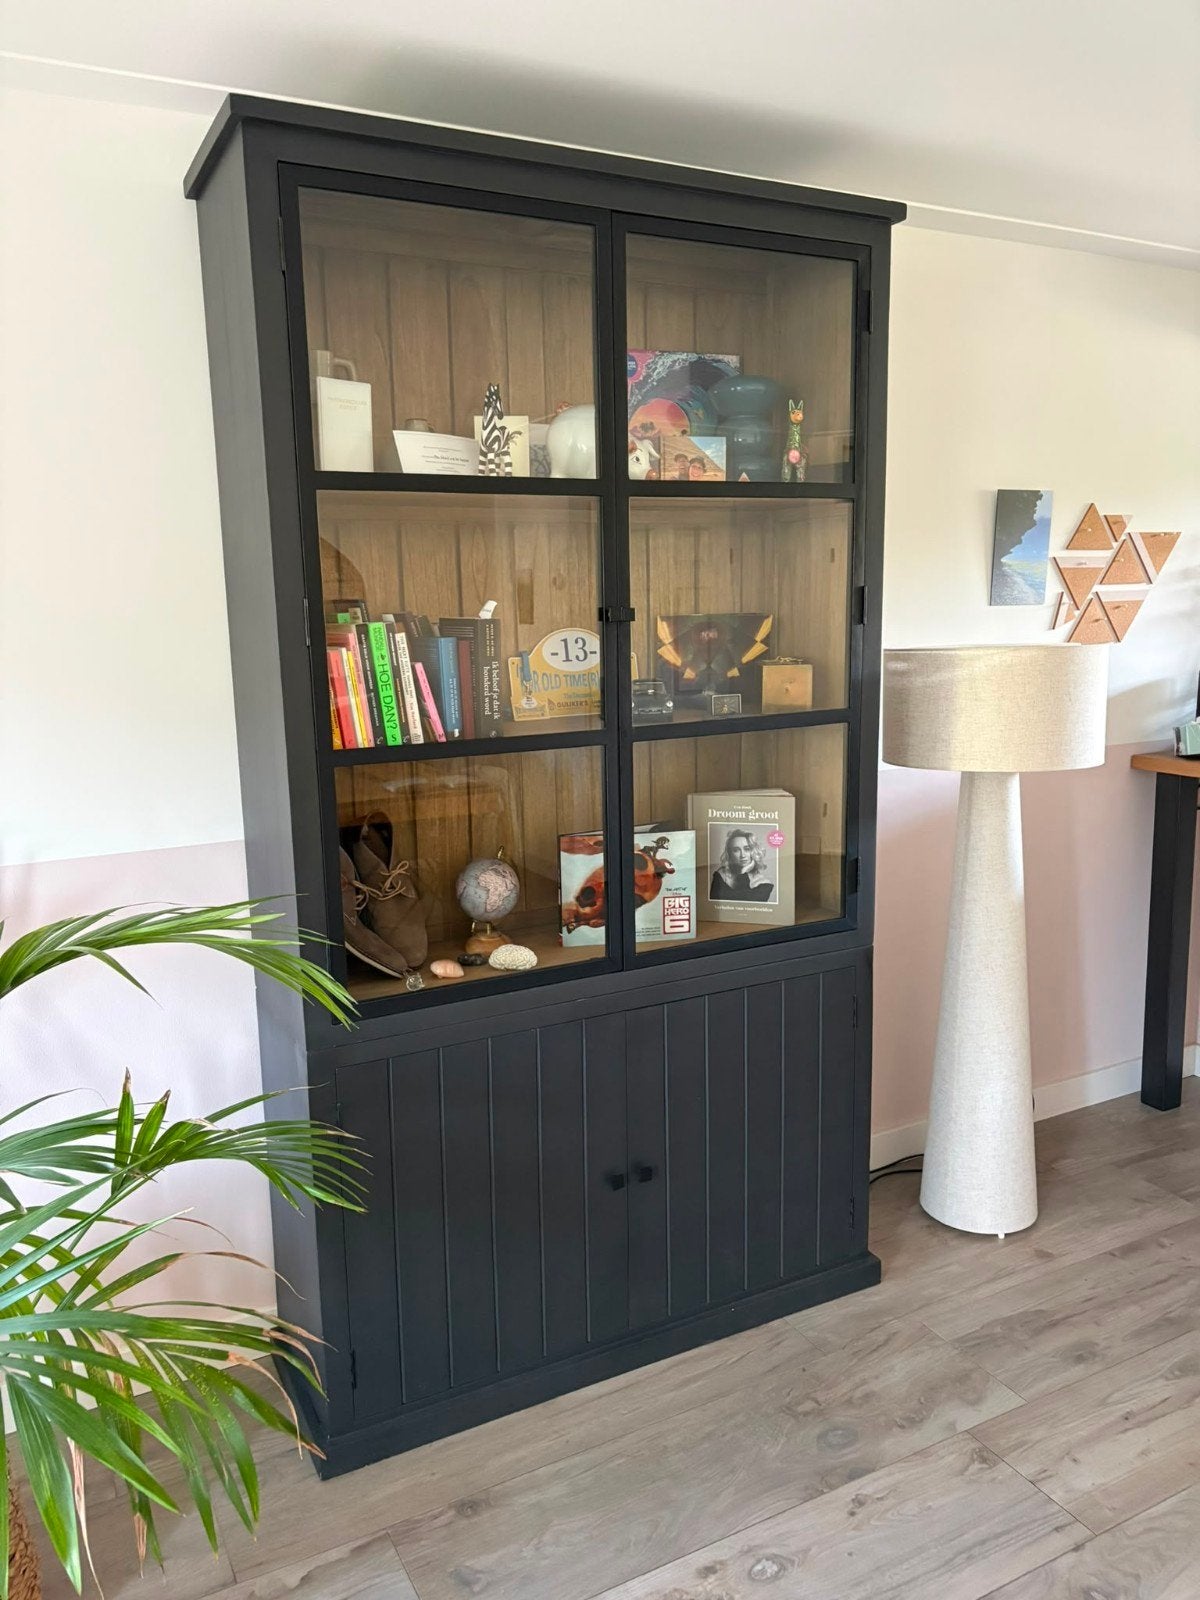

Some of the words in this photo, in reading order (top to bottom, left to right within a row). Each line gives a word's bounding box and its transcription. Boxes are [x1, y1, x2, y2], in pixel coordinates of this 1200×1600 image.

[492, 661, 499, 669] Ik
[378, 663, 392, 692] HOE
[483, 666, 491, 696] honderd
[492, 669, 500, 692] beloof
[542, 672, 561, 691] OLD
[490, 692, 500, 700] je
[383, 695, 398, 730] DAN?
[494, 712, 500, 720] ik
[708, 808, 746, 818] Droom
[748, 809, 779, 820] groot
[665, 897, 690, 908] BIG
[665, 907, 690, 916] HERO
[664, 914, 690, 934] 6
